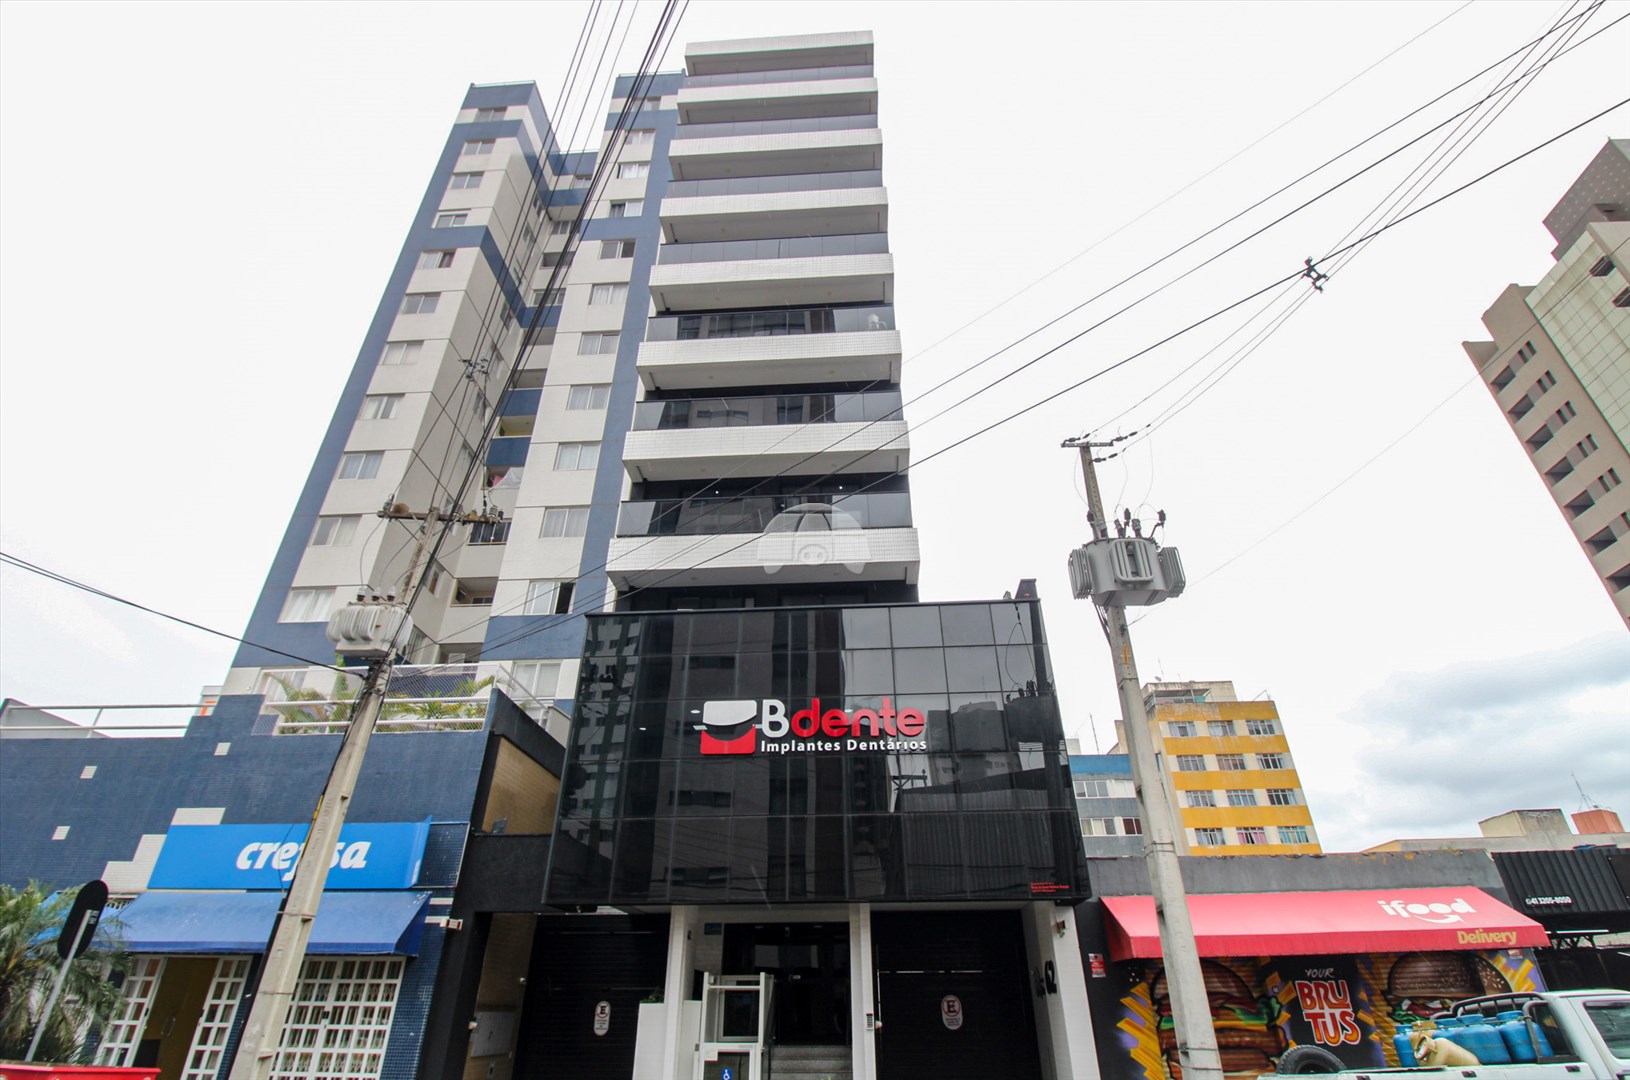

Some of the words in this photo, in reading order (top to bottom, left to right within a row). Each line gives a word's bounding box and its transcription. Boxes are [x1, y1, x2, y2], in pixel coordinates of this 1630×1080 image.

[762, 697, 925, 738] Bdente
[761, 739, 841, 754] Implantes
[847, 736, 928, 751] Dentários
[236, 841, 371, 881] cresa
[1377, 898, 1477, 918] ifood
[1457, 928, 1517, 945] Delivery
[1305, 967, 1335, 978] YOUR
